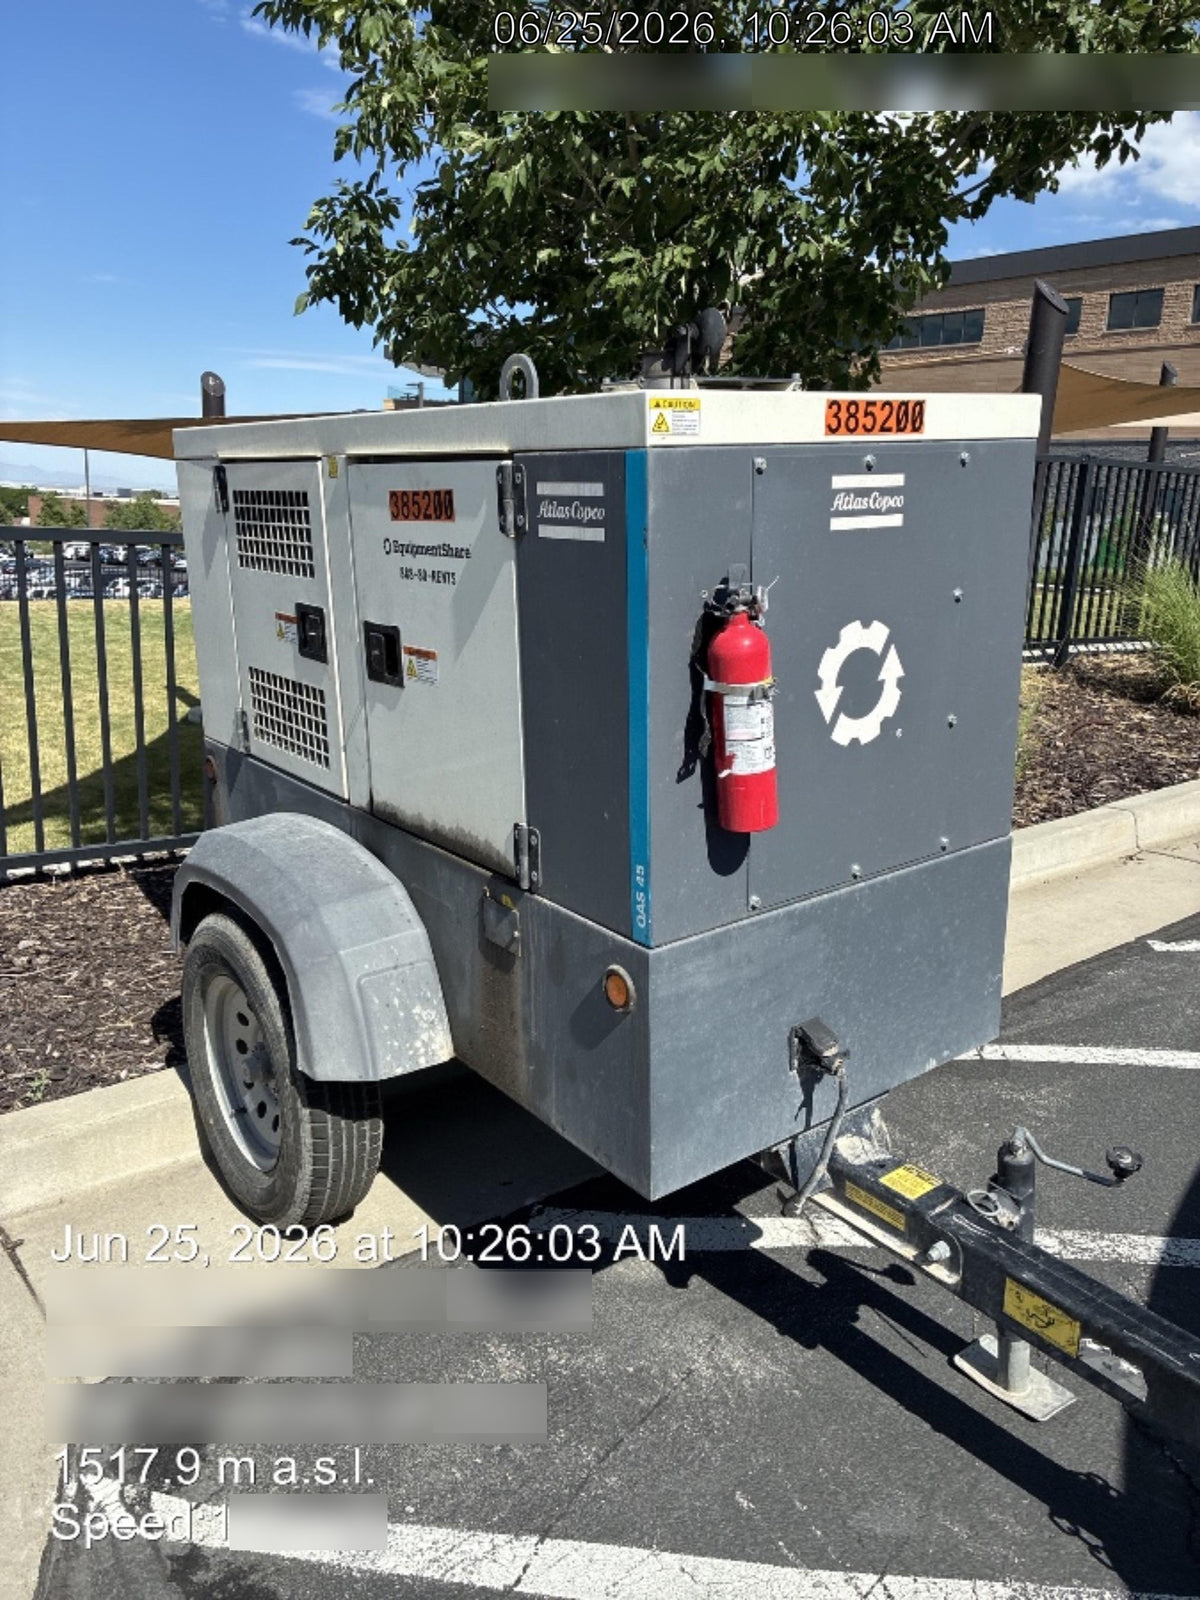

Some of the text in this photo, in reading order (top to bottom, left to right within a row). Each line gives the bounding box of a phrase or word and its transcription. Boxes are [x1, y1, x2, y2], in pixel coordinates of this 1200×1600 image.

[826, 399, 925, 434] 385200
[390, 489, 454, 520] 385200
[536, 500, 606, 523] Atlas Copco
[830, 491, 904, 512] Atlas Copco
[392, 540, 472, 559] EquipmentShare
